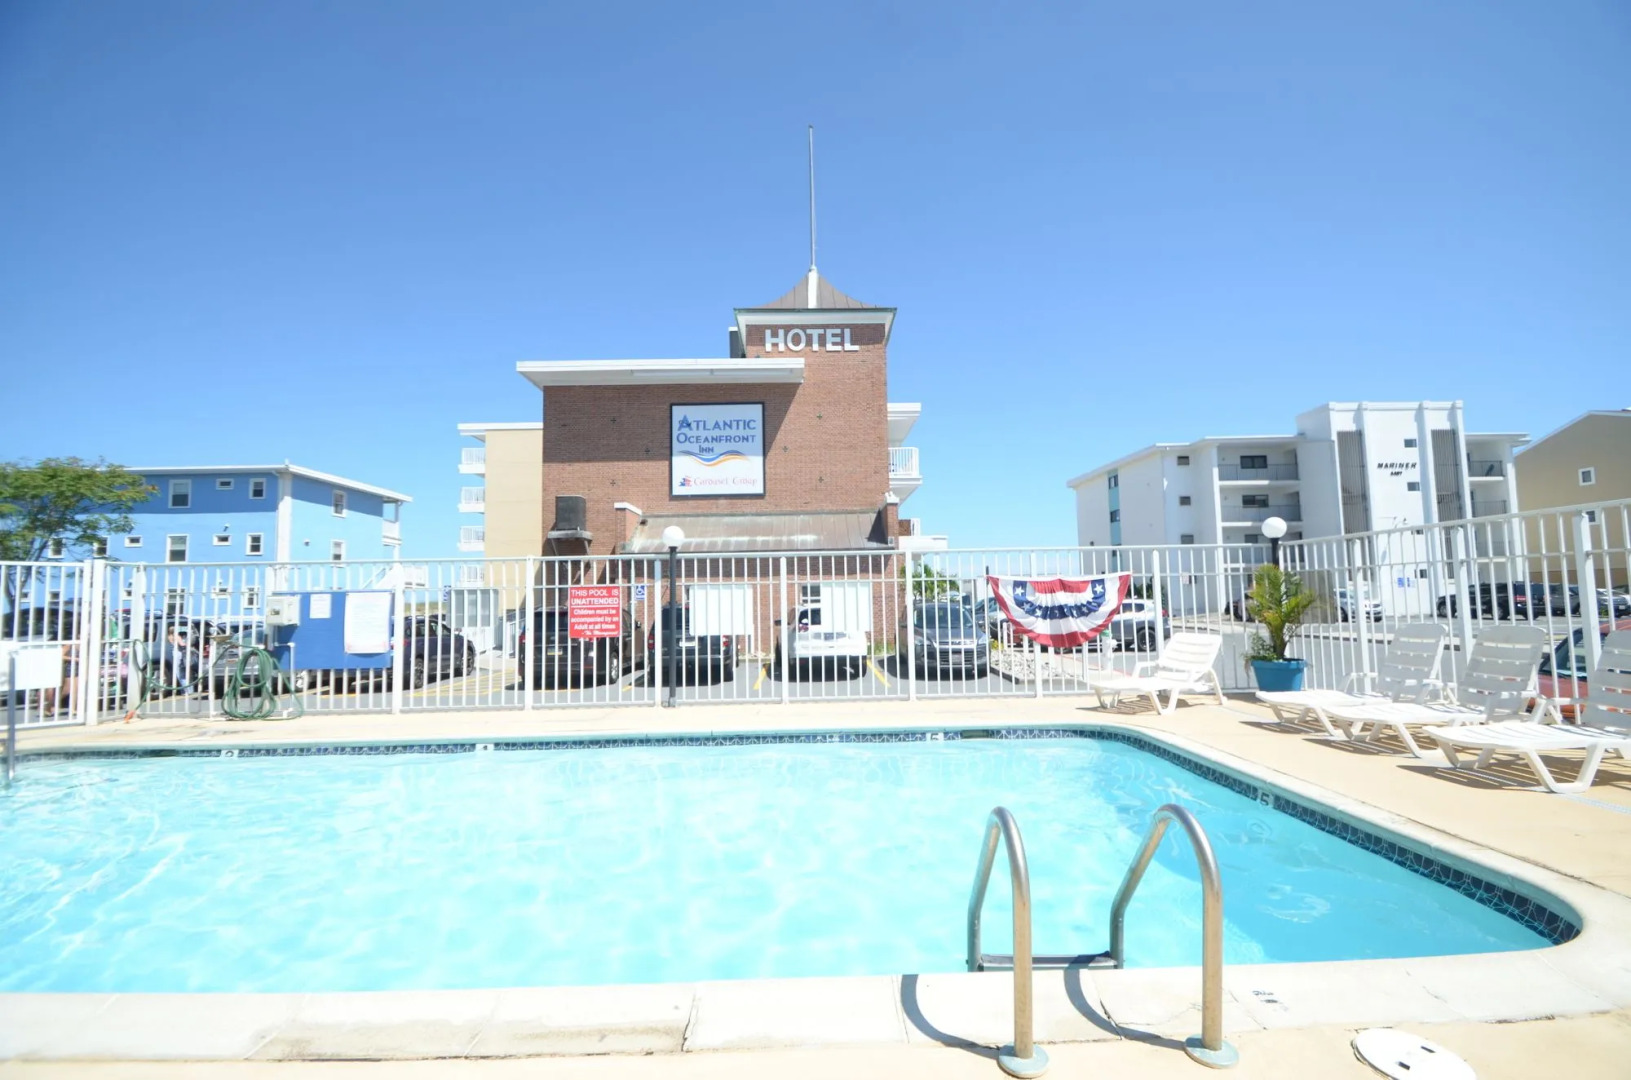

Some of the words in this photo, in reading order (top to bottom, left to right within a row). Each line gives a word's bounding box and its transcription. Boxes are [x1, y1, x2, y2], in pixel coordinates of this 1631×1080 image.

[764, 328, 860, 352] HOTEL
[677, 414, 757, 431] ATLANTIC
[676, 432, 757, 444] OCEANFRONT
[698, 444, 715, 453] INN
[693, 476, 728, 486] Carousel
[732, 476, 758, 487] Group
